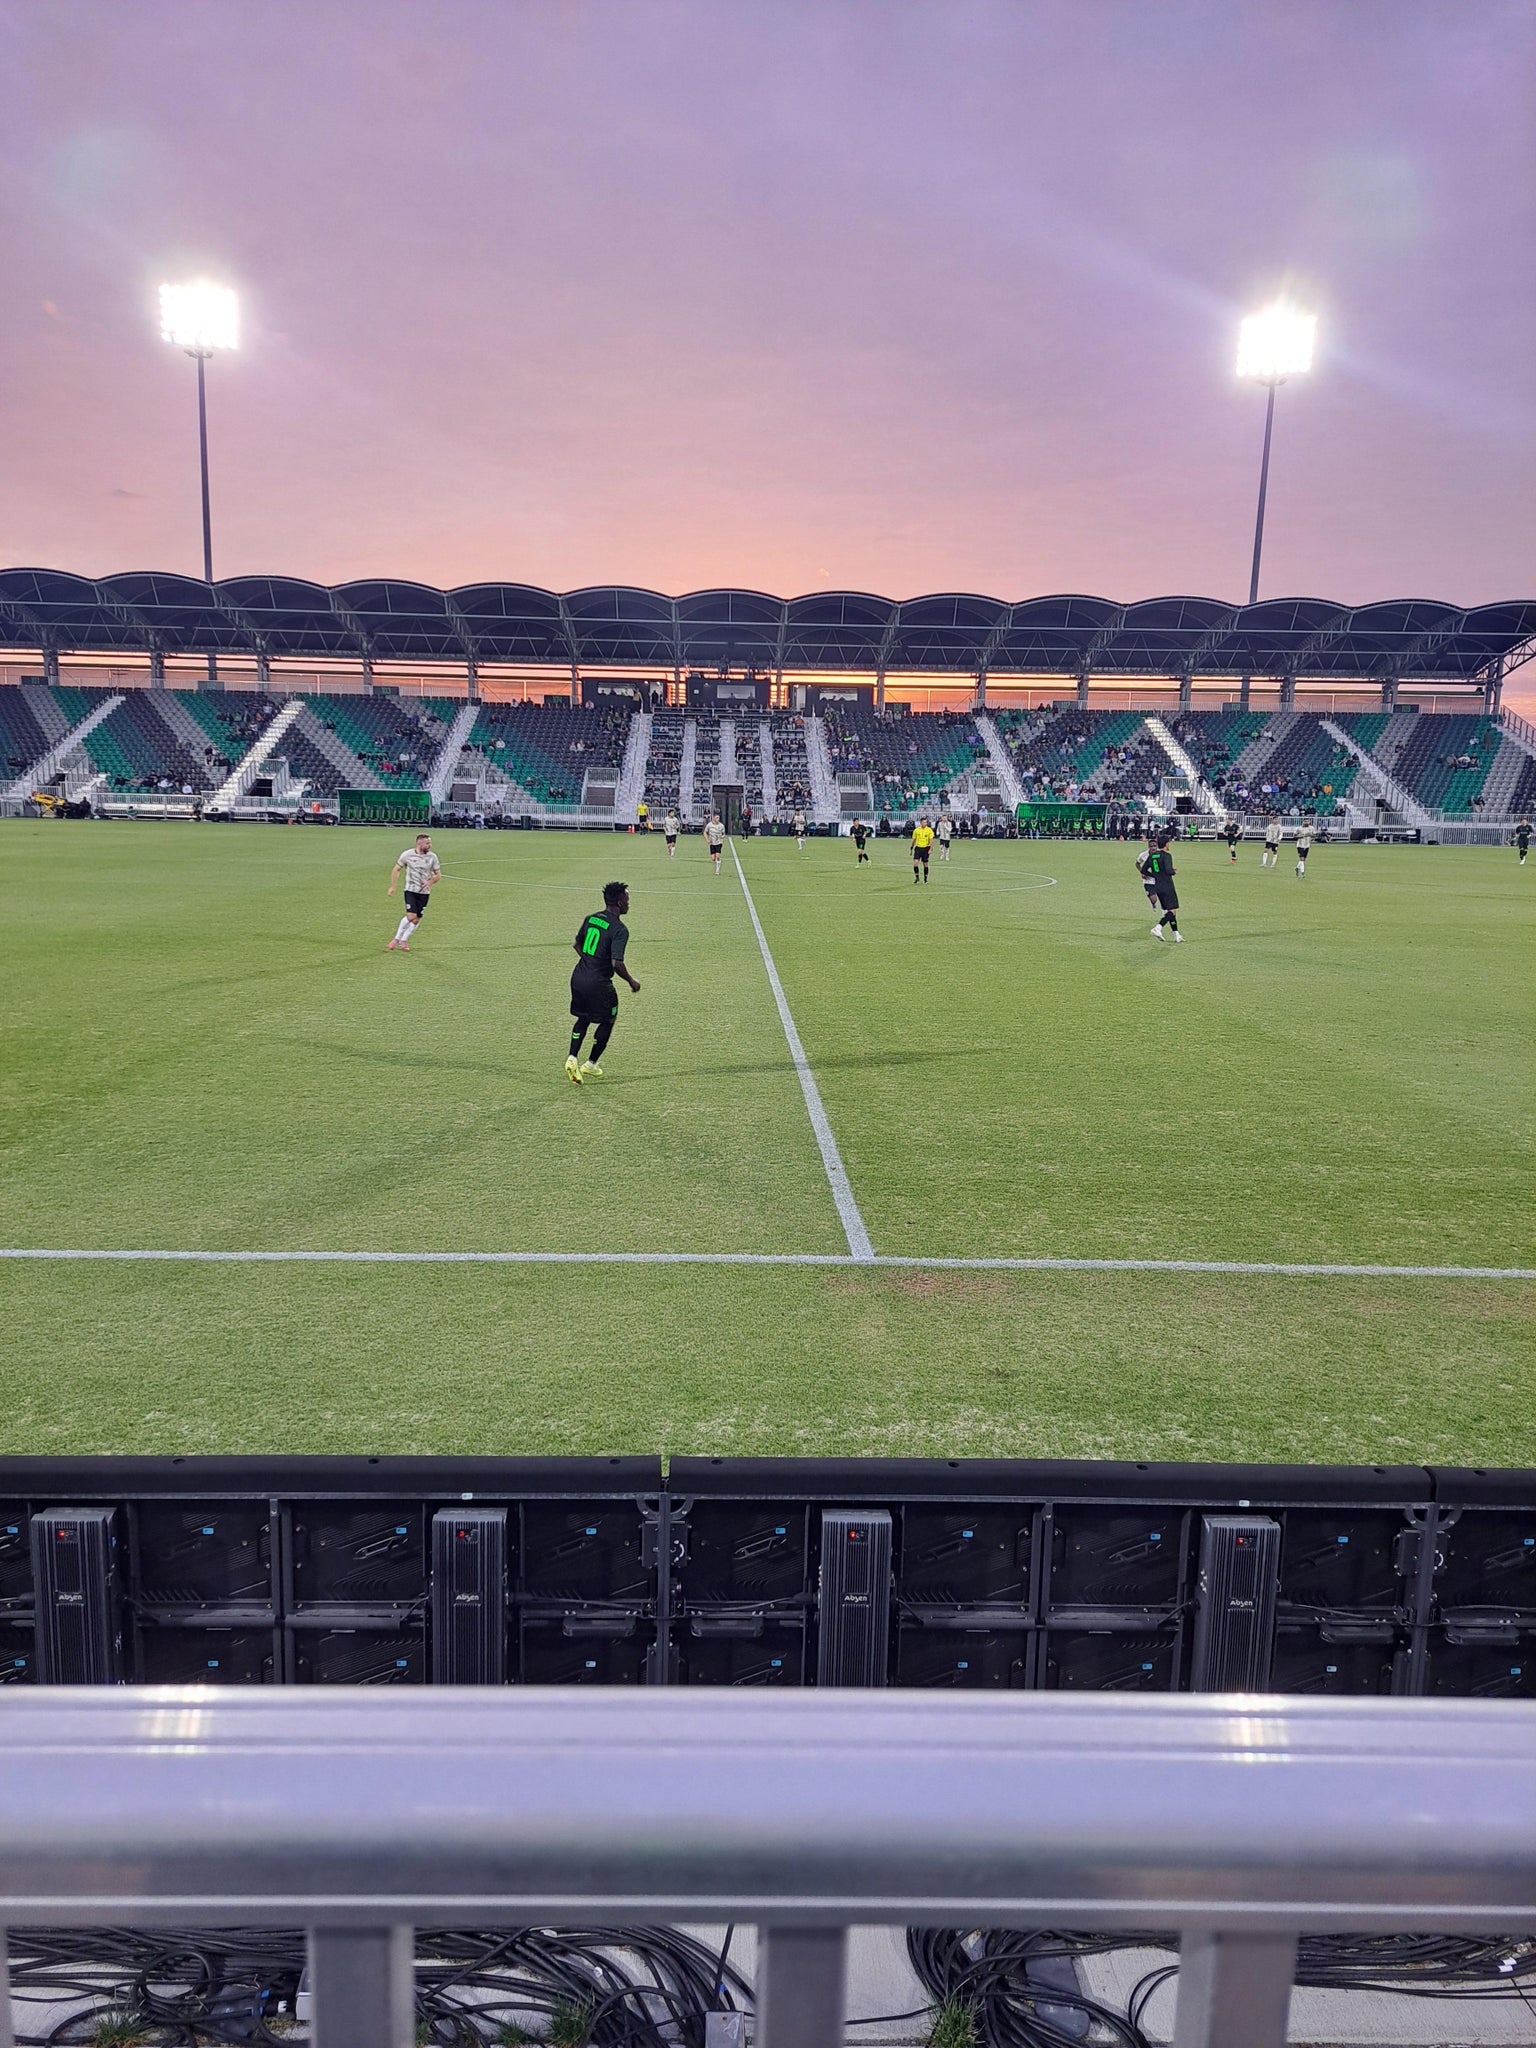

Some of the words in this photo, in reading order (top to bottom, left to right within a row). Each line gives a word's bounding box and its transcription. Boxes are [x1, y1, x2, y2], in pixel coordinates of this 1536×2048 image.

[583, 927, 600, 956] 10
[59, 1594, 82, 1602] Absen
[456, 1594, 480, 1602] Absen
[844, 1595, 868, 1603] Absen
[1230, 1600, 1253, 1608] Absen
